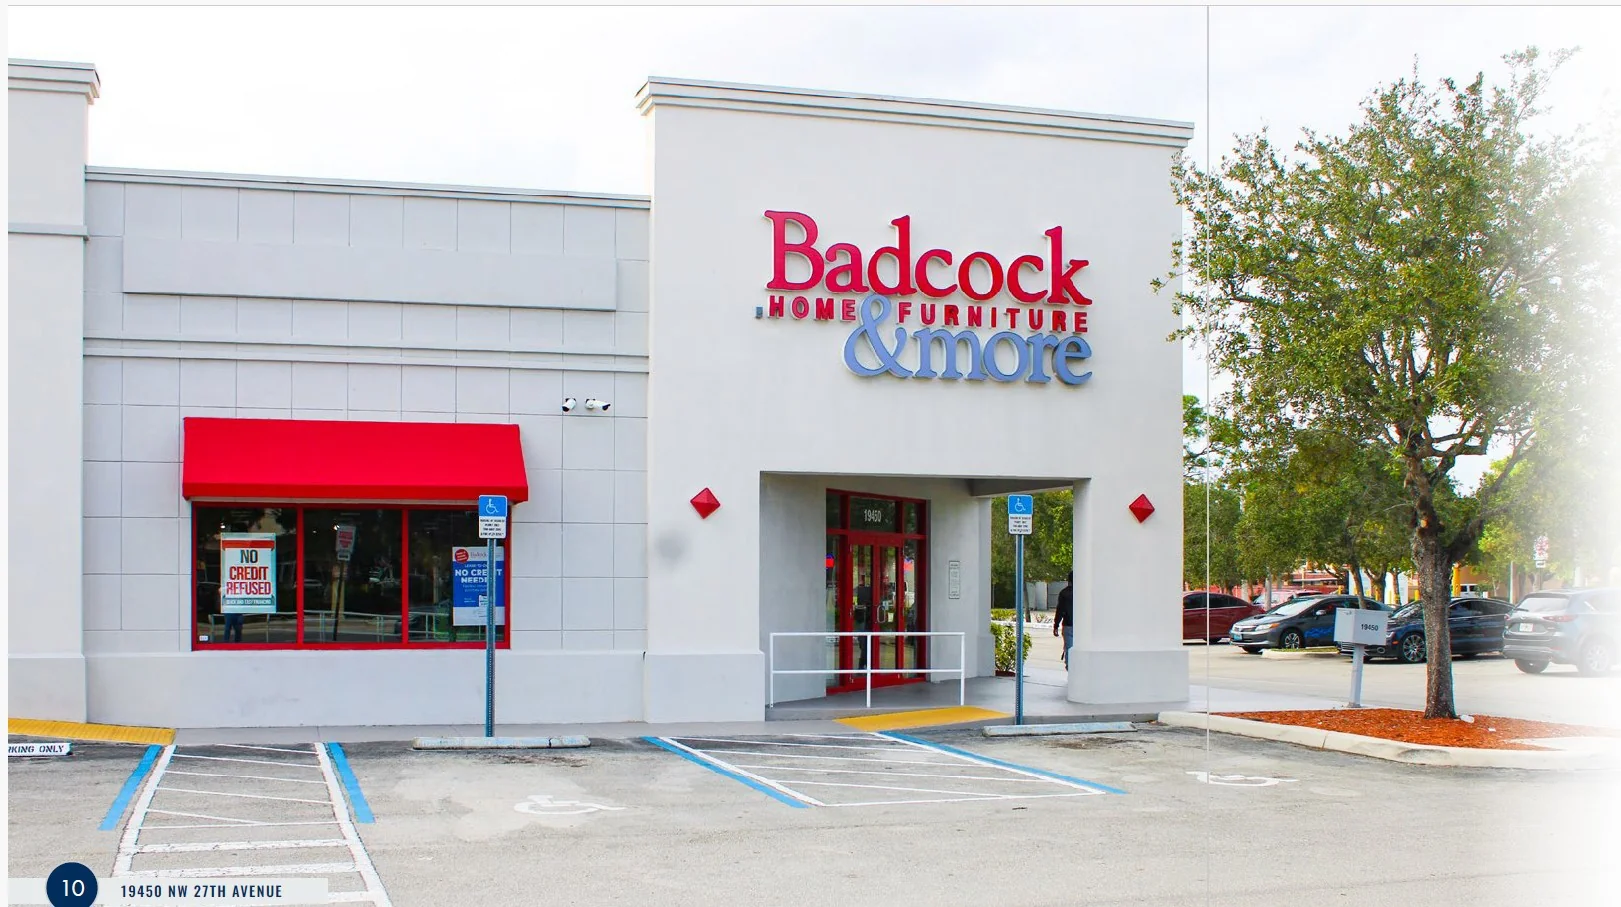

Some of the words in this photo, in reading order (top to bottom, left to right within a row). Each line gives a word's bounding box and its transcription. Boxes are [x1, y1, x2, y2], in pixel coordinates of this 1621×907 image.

[763, 209, 1093, 306] Badcock
[768, 294, 857, 321] HOME
[897, 301, 1088, 333] FURNITURE
[864, 509, 882, 522] 19450
[240, 549, 258, 564] NO
[229, 566, 269, 580] CREDIT
[226, 581, 271, 595] REFUSED
[39, 745, 64, 753] ONLY
